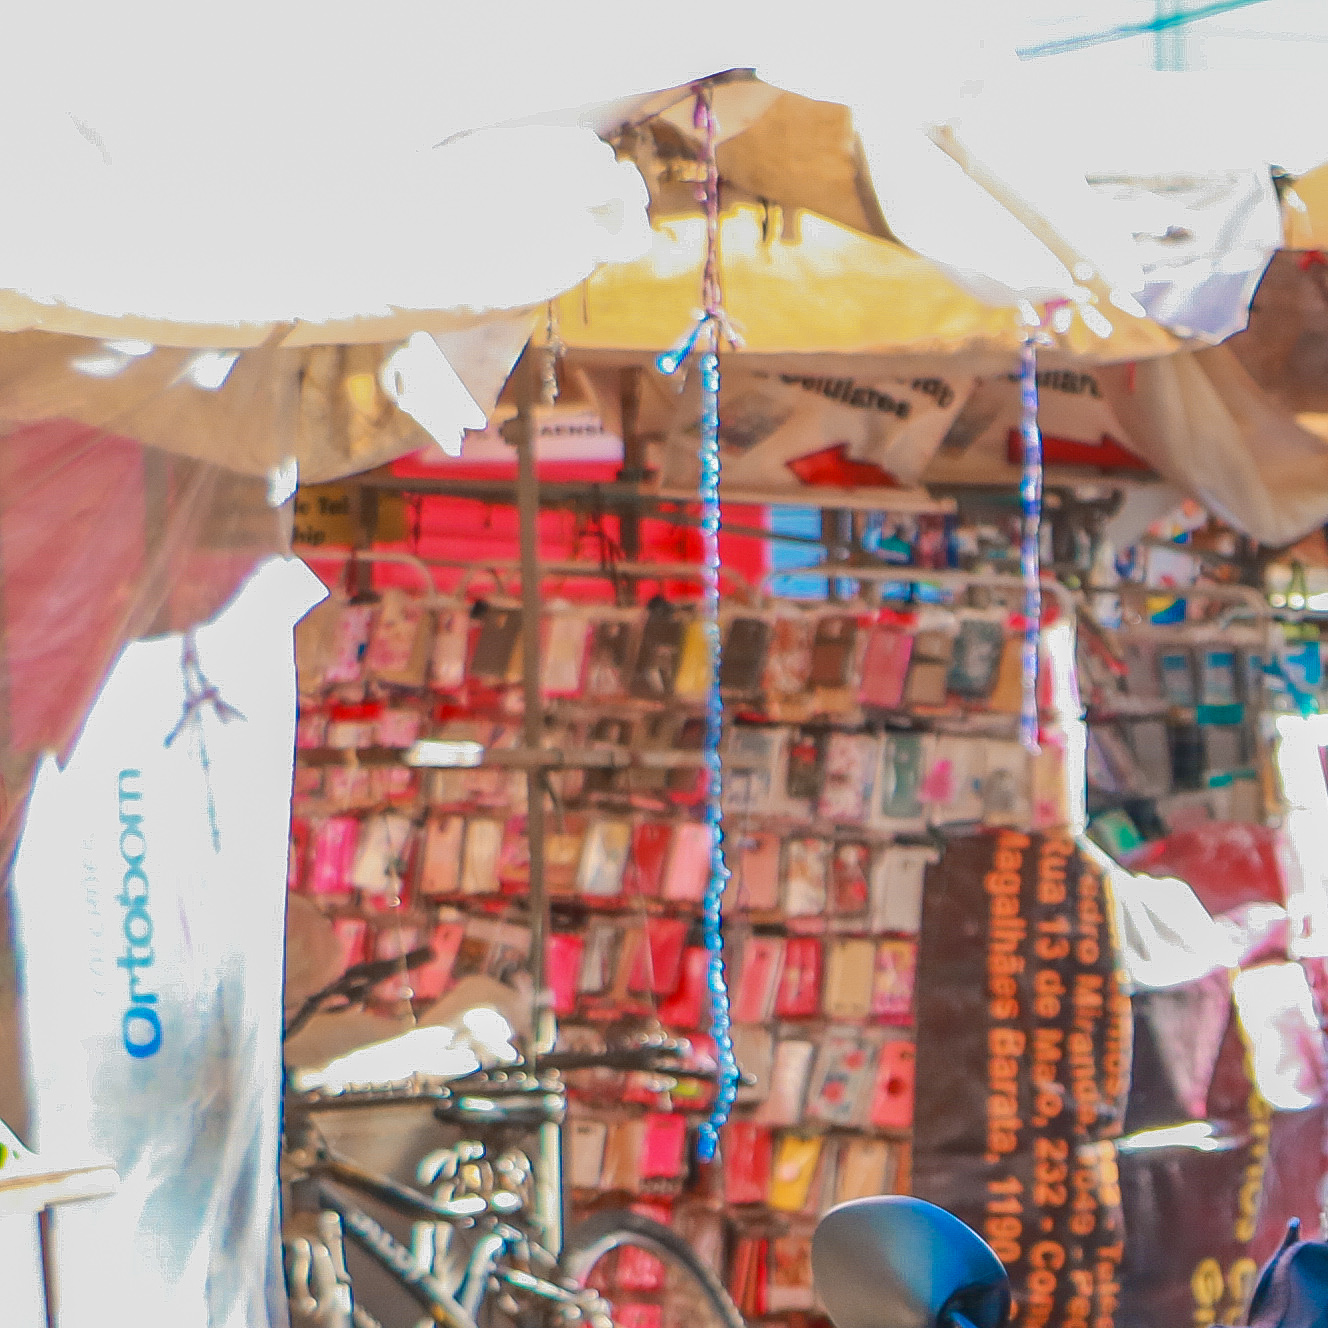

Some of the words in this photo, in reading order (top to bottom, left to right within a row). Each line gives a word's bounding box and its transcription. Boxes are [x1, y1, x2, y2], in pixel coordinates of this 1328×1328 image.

[115, 769, 163, 1059] Ortobom
[1035, 914, 1071, 960] 13
[1033, 968, 1067, 1018] de
[984, 1027, 1027, 1164] Barata,
[1033, 1137, 1069, 1207] 232
[984, 1175, 1024, 1263] 1190
